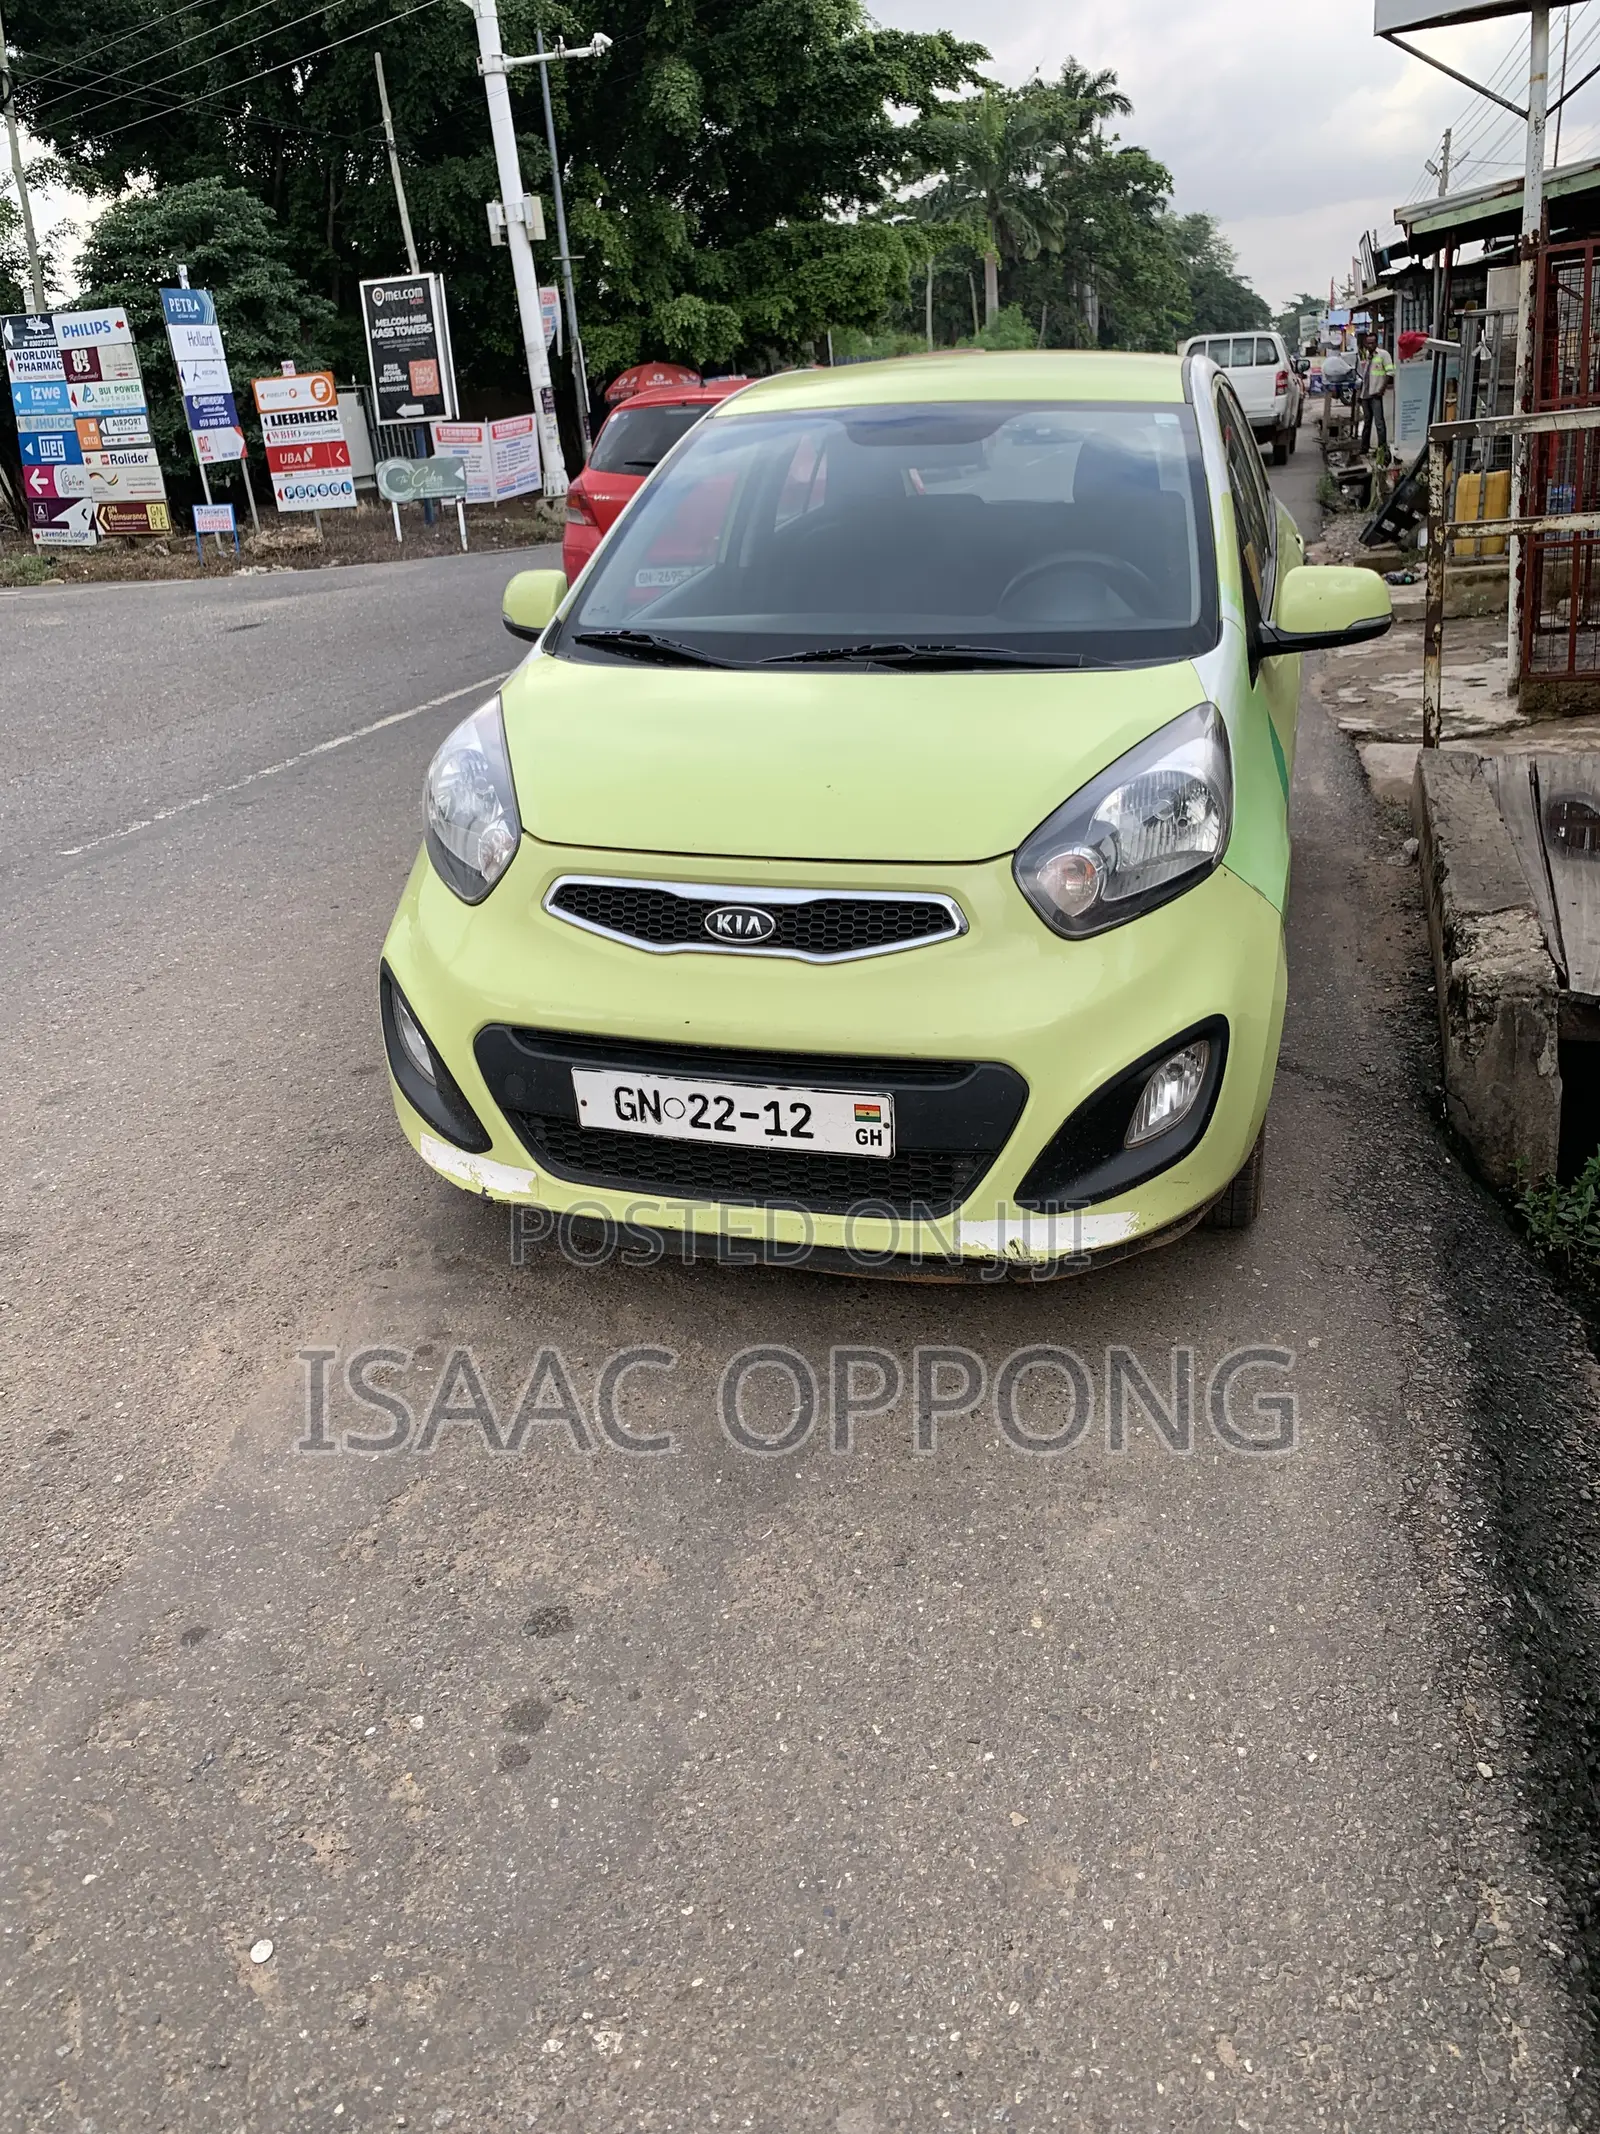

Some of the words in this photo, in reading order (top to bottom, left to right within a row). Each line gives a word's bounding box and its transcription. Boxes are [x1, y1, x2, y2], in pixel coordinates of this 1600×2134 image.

[168, 298, 201, 313] PETRA
[62, 320, 111, 338] PHILIPS
[375, 317, 409, 327] MELCOM
[395, 323, 433, 336] TOWERS
[17, 360, 63, 373] PHARMAC
[30, 385, 61, 400] izwe
[98, 387, 111, 395] BUI
[114, 384, 140, 394] POWER
[112, 418, 142, 427] AIRPORT
[270, 409, 339, 427] LIEBHERR
[110, 452, 149, 465] Rolider
[280, 452, 302, 464] UBA
[284, 481, 353, 499] PERSOL
[716, 913, 763, 936] KIA
[614, 1086, 662, 1124] GN
[687, 1093, 815, 1139] 22-12
[855, 1128, 883, 1147] GH
